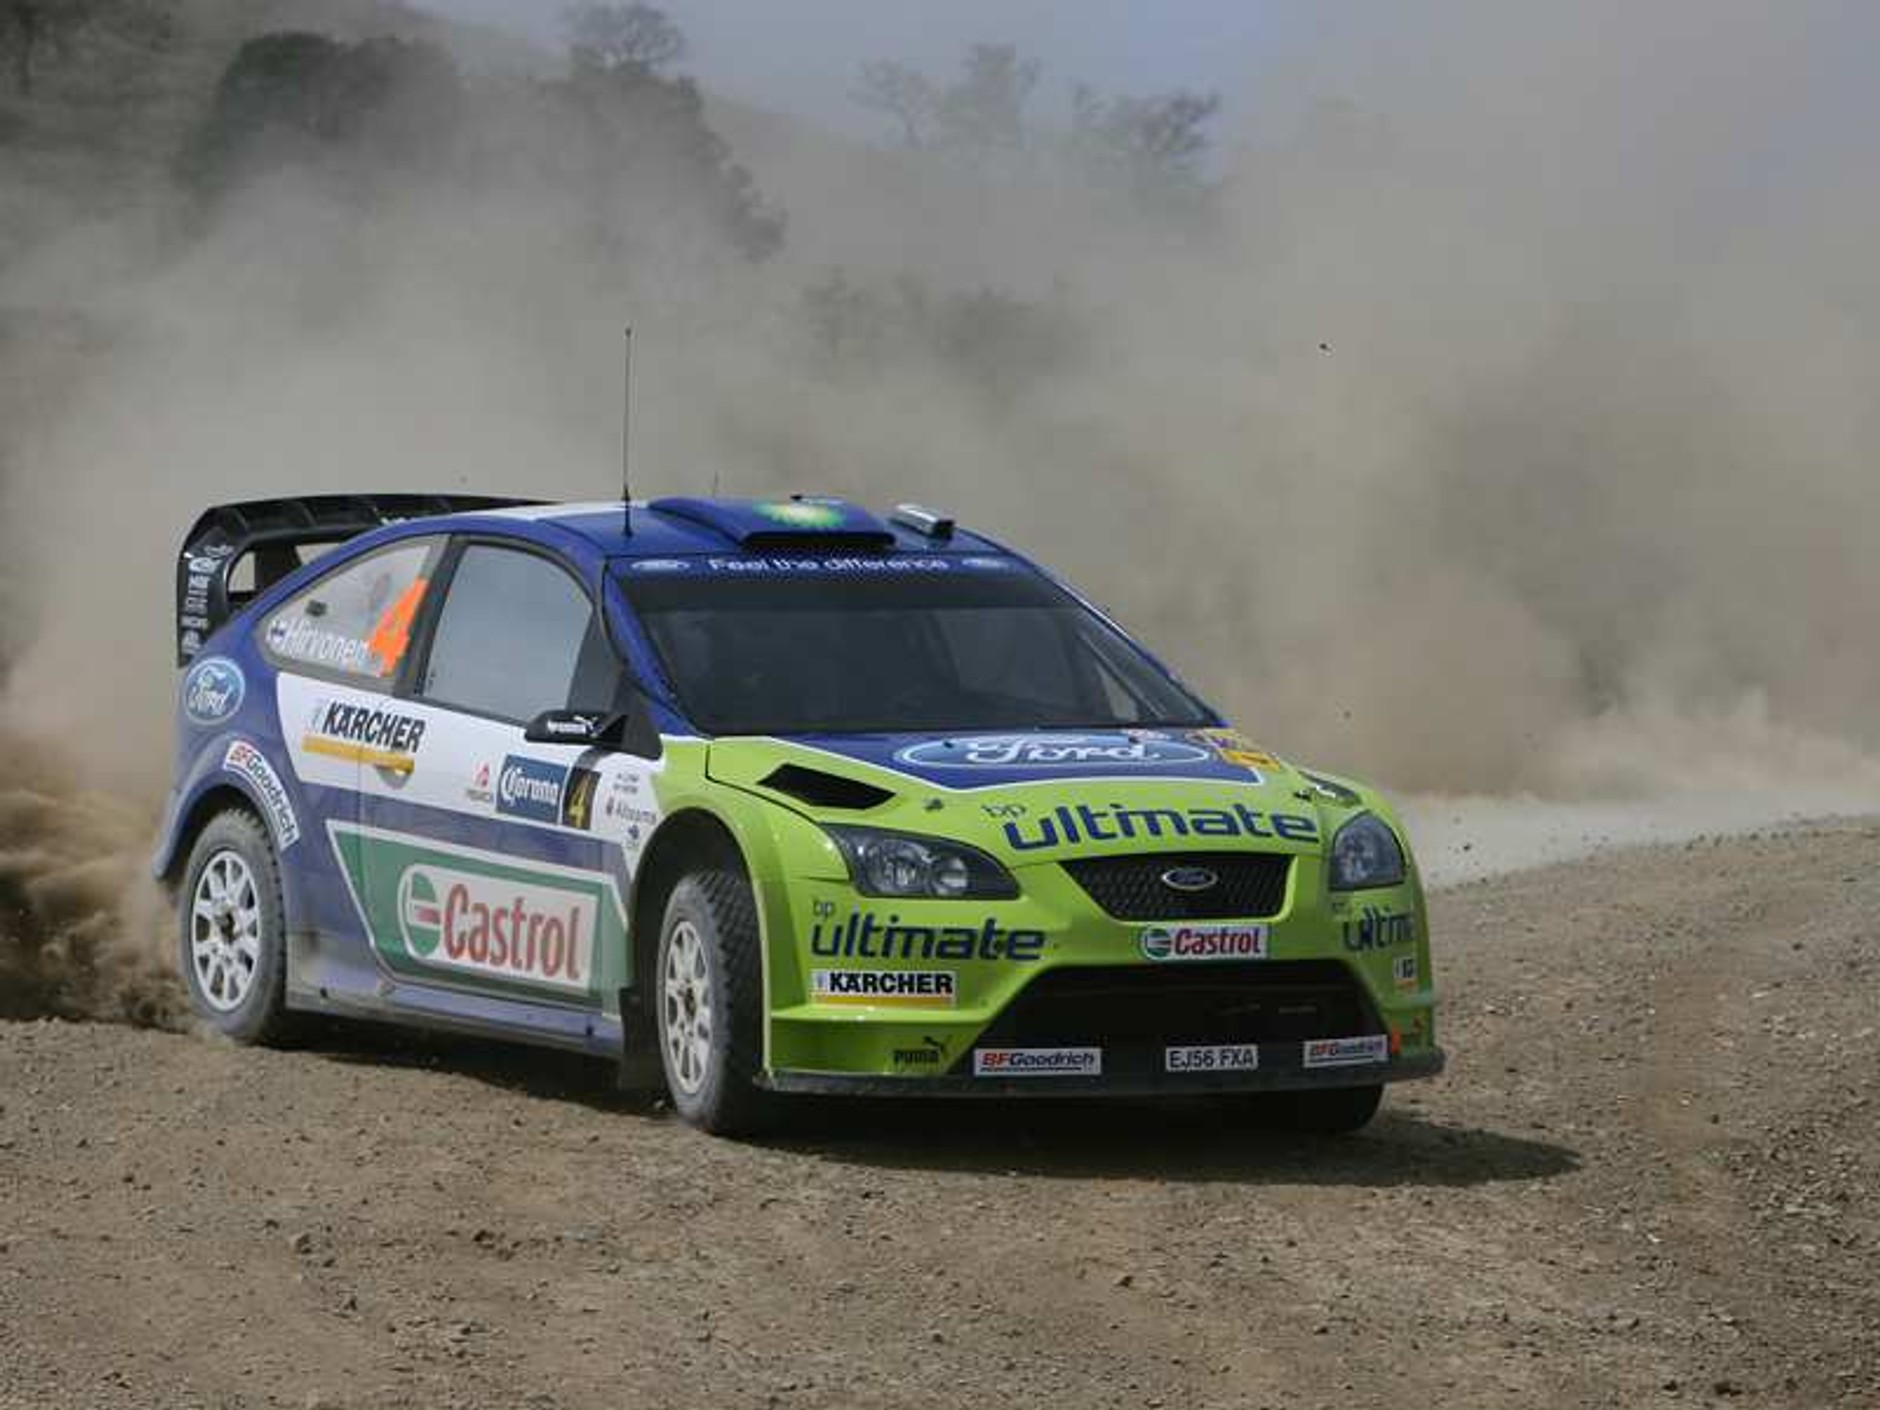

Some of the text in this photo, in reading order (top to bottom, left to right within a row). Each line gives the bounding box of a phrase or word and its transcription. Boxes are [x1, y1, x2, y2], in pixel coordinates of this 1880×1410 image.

[368, 577, 429, 676] 4
[322, 699, 425, 754] KÄRCHER
[964, 736, 1150, 763] Ford
[227, 743, 297, 845] BFGoodrich
[500, 763, 560, 807] Corona
[567, 773, 592, 829] 4
[981, 803, 1027, 818] bp
[1002, 802, 1320, 851] ultimate
[812, 899, 835, 919] bp
[444, 883, 581, 981] Castrol
[811, 912, 1046, 961] ultimate
[1175, 926, 1261, 956] Castrol
[829, 972, 954, 995] KÄRCHER
[981, 1051, 1095, 1067] BFGoodrich
[1169, 1048, 1254, 1069] EJ56 FXA
